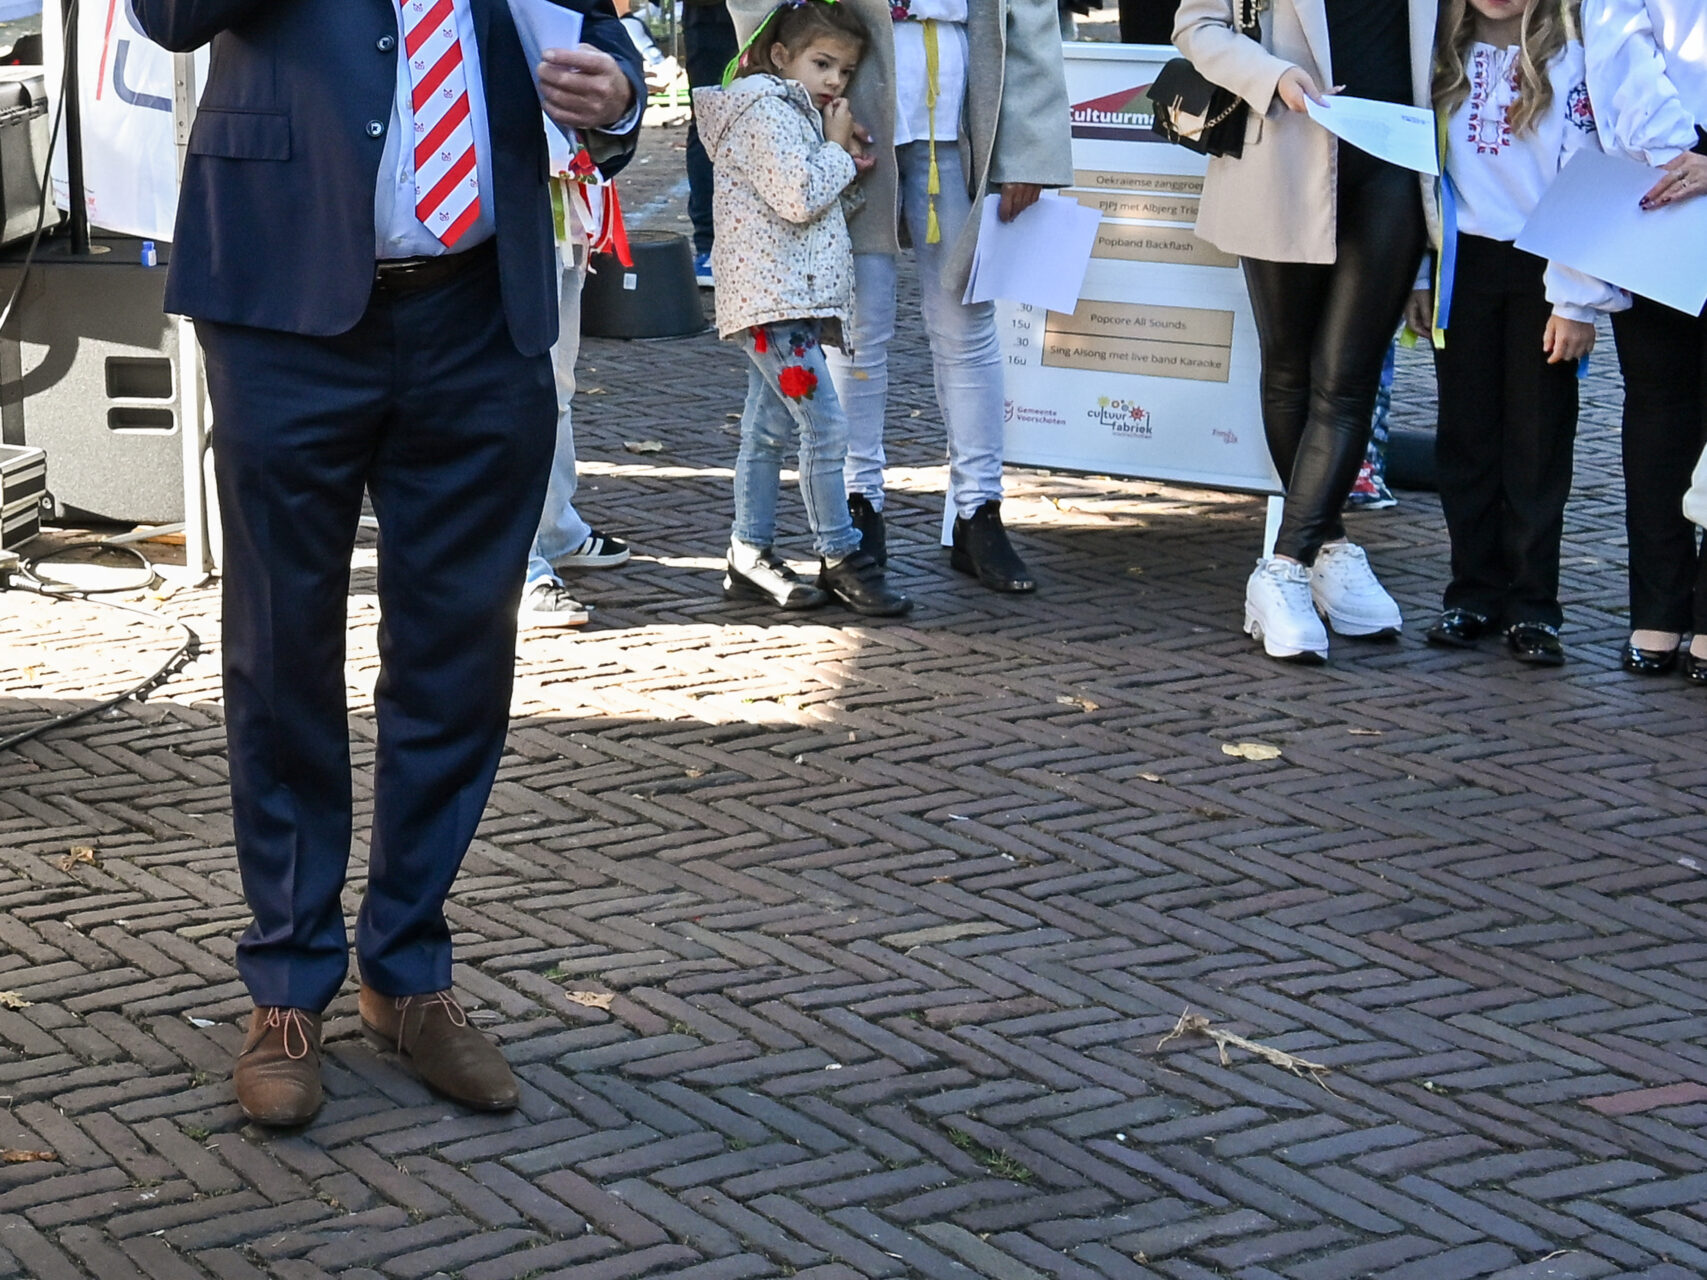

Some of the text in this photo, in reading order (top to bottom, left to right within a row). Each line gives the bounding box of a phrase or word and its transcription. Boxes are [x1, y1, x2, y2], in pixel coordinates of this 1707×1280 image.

[1098, 236, 1194, 252] Popband Backflash
[1012, 319, 1031, 330] 15u
[1090, 313, 1132, 326] Popcore
[1149, 319, 1188, 331] Sounds
[1008, 355, 1027, 365] 16u
[1050, 345, 1071, 357] Sing
[1109, 352, 1129, 360] met
[1131, 353, 1148, 363] live
[1151, 354, 1178, 365] band
[1180, 357, 1222, 369] Karaoke
[1111, 420, 1153, 434] fabriek
